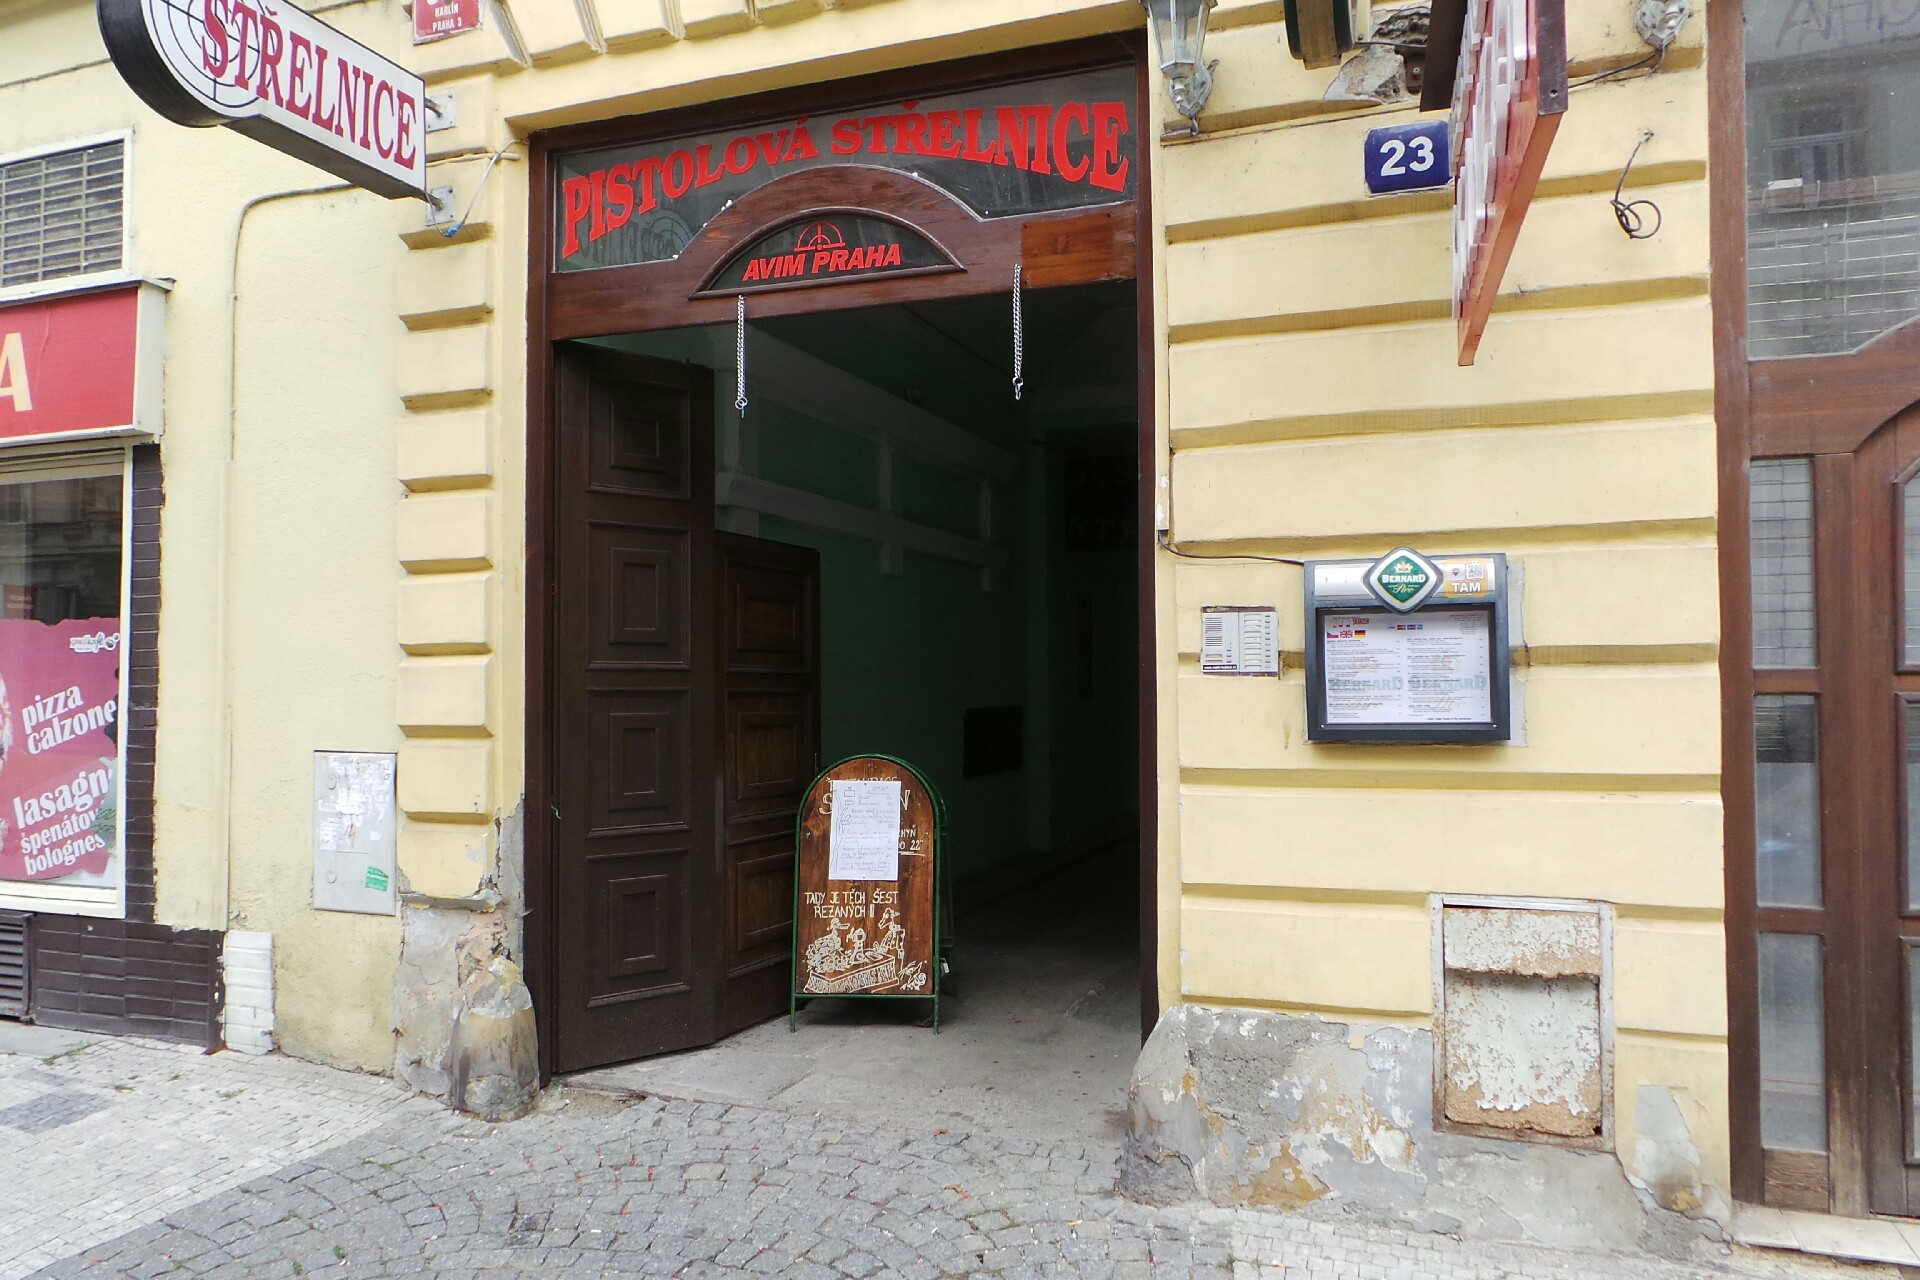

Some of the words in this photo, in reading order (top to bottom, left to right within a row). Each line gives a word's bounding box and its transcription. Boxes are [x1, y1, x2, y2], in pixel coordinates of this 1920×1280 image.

[433, 18, 455, 31] PRAHA
[435, 2, 459, 17] KARLÍN
[202, 0, 417, 170] STŘELNICE
[1380, 136, 1434, 176] 23
[562, 115, 819, 259] PISTOLOVÁ
[831, 99, 1130, 192] STŘELNICE
[743, 253, 806, 281] AVIM
[812, 243, 901, 274] PRAHA
[1382, 574, 1426, 583] BERNARD
[1451, 582, 1481, 592] TAM
[22, 686, 84, 735] pizza
[28, 700, 117, 755] calzone
[21, 807, 100, 855] špenátov
[804, 892, 826, 904] TADY
[830, 891, 840, 904] JE
[842, 888, 865, 904] TĚCH
[872, 888, 899, 904] ŠEST
